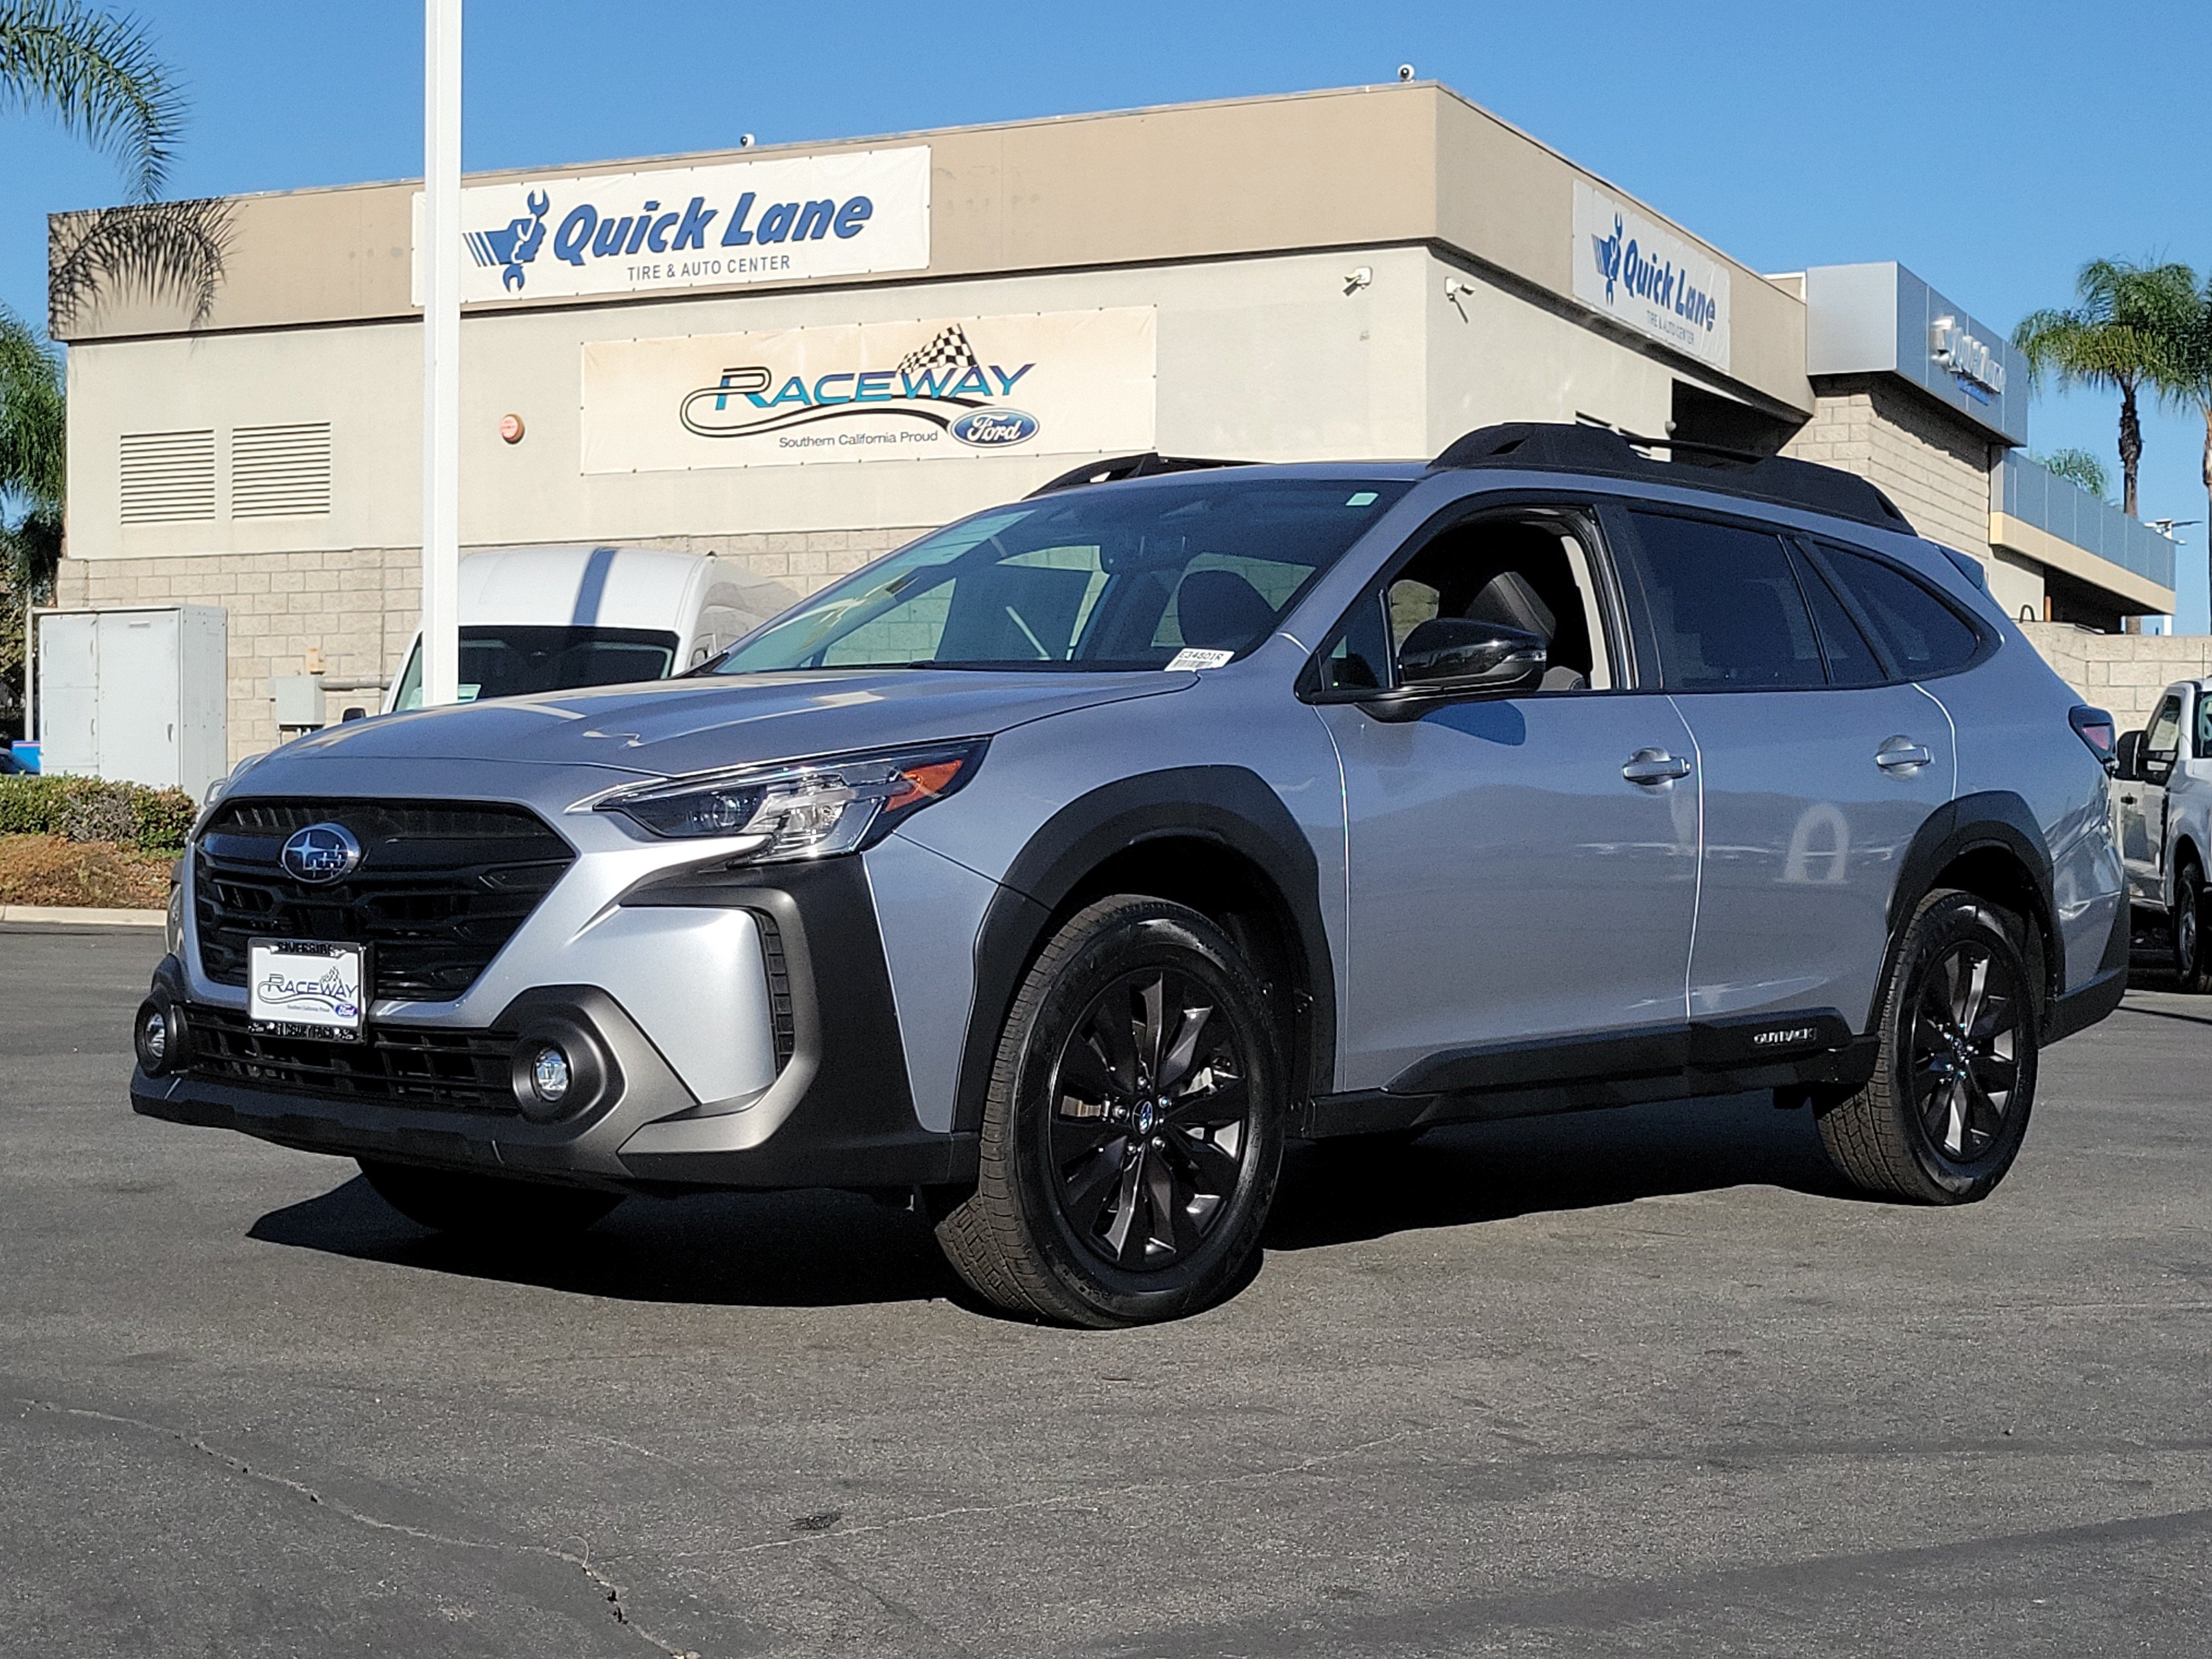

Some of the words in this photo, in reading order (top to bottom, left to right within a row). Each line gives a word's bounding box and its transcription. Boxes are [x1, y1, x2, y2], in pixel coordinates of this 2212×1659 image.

[554, 197, 718, 266] Quick
[720, 192, 873, 246] Lane
[627, 264, 661, 281] TIRE
[667, 263, 676, 278] &
[680, 260, 722, 277] AUTO
[727, 255, 790, 273] CENTER
[1623, 239, 1674, 310] Quick
[1675, 268, 1716, 332] Lane
[713, 363, 1037, 410] RACEWAY
[778, 435, 835, 448] Southern
[838, 432, 896, 445] California
[900, 430, 939, 443] Proud
[967, 414, 1024, 442] Ford
[268, 974, 359, 998] RACEWAY
